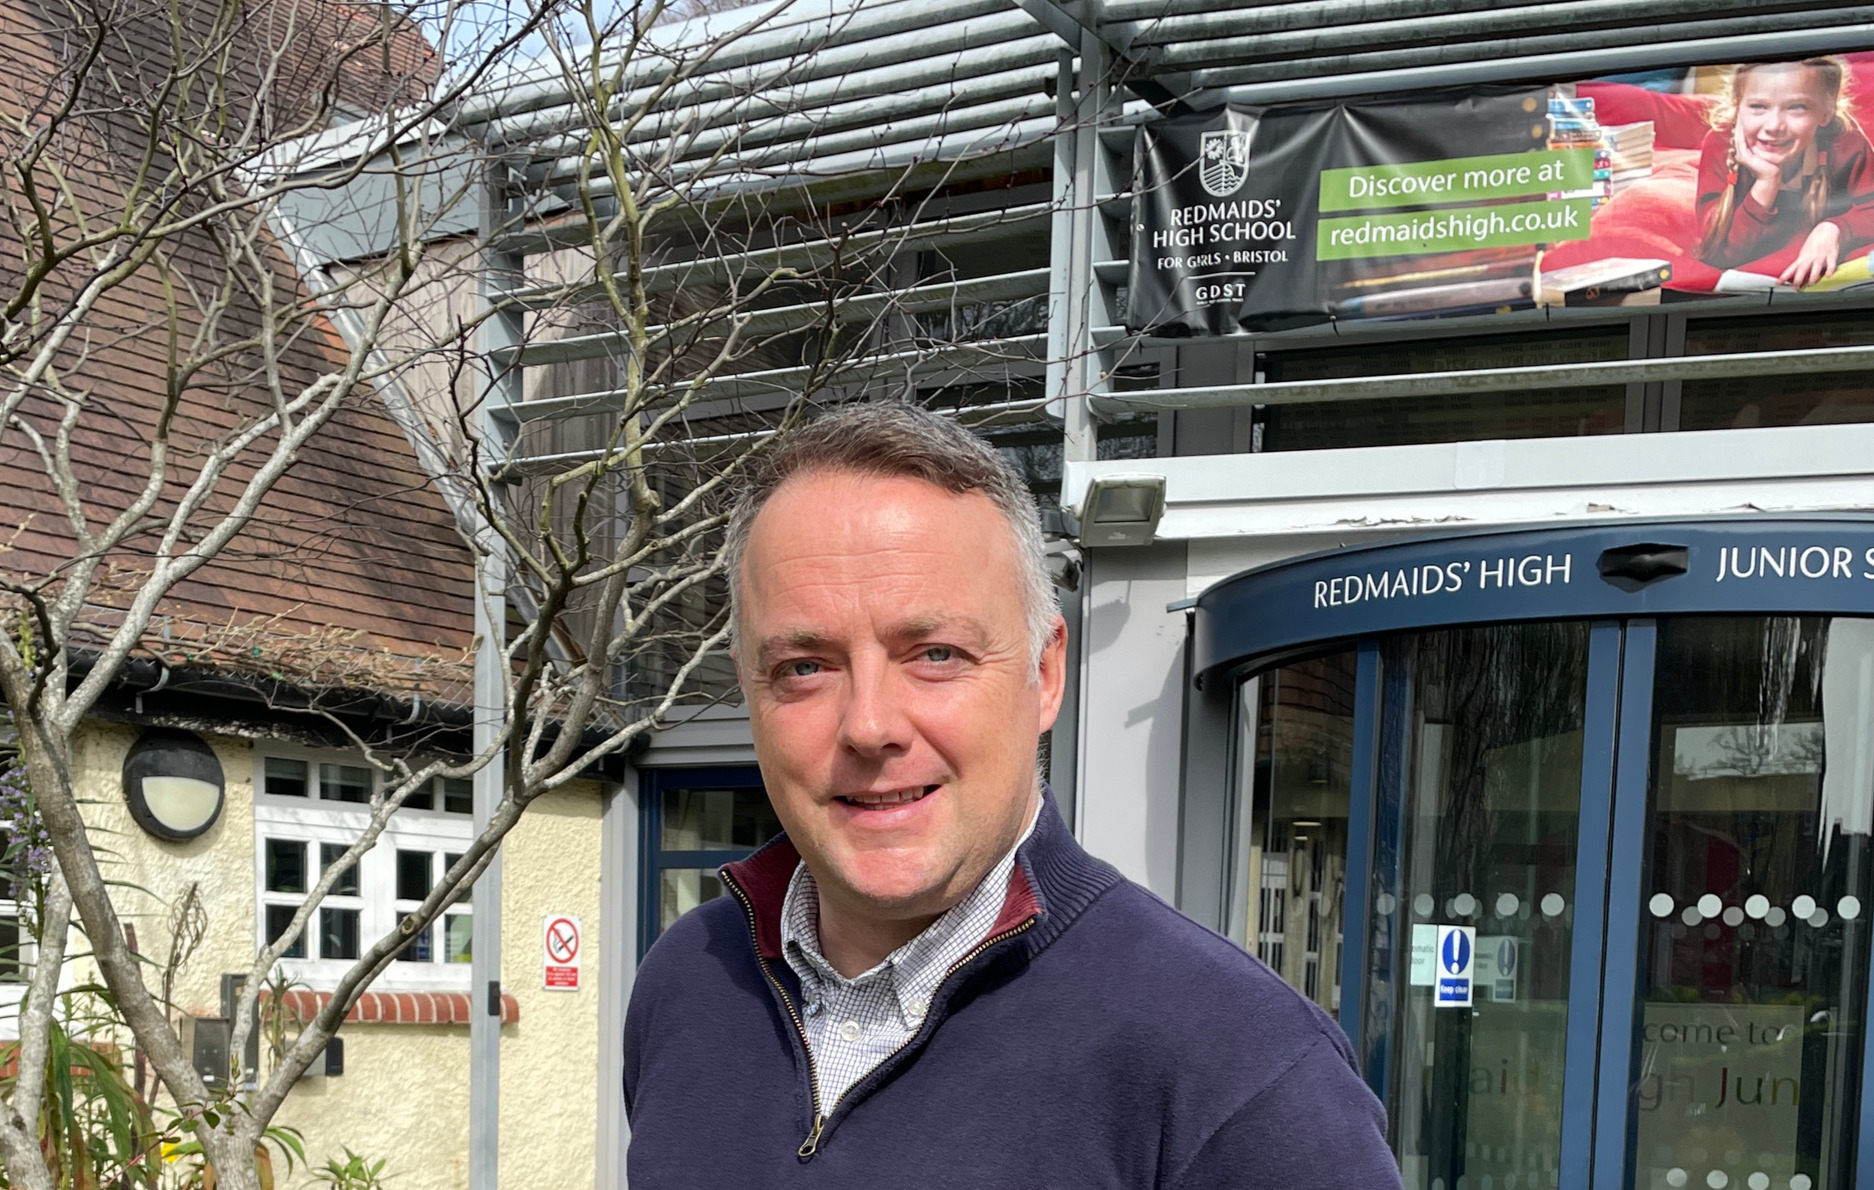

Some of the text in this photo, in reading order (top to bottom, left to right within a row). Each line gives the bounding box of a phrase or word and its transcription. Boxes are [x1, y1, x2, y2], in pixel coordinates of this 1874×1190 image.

[1349, 159, 1565, 198] Discover more at
[1170, 198, 1282, 227] REDMAIDS'
[1331, 204, 1579, 246] redmaidshigh.co.uk
[1153, 220, 1297, 249] HIGH SCHOOL
[1157, 250, 1289, 270] FOR GIRLS BRISTOL
[1195, 283, 1247, 300] GDST
[1313, 560, 1471, 609] REDMAIDS'
[1479, 553, 1572, 590] HIGH
[1715, 546, 1853, 583] JUNIOR
